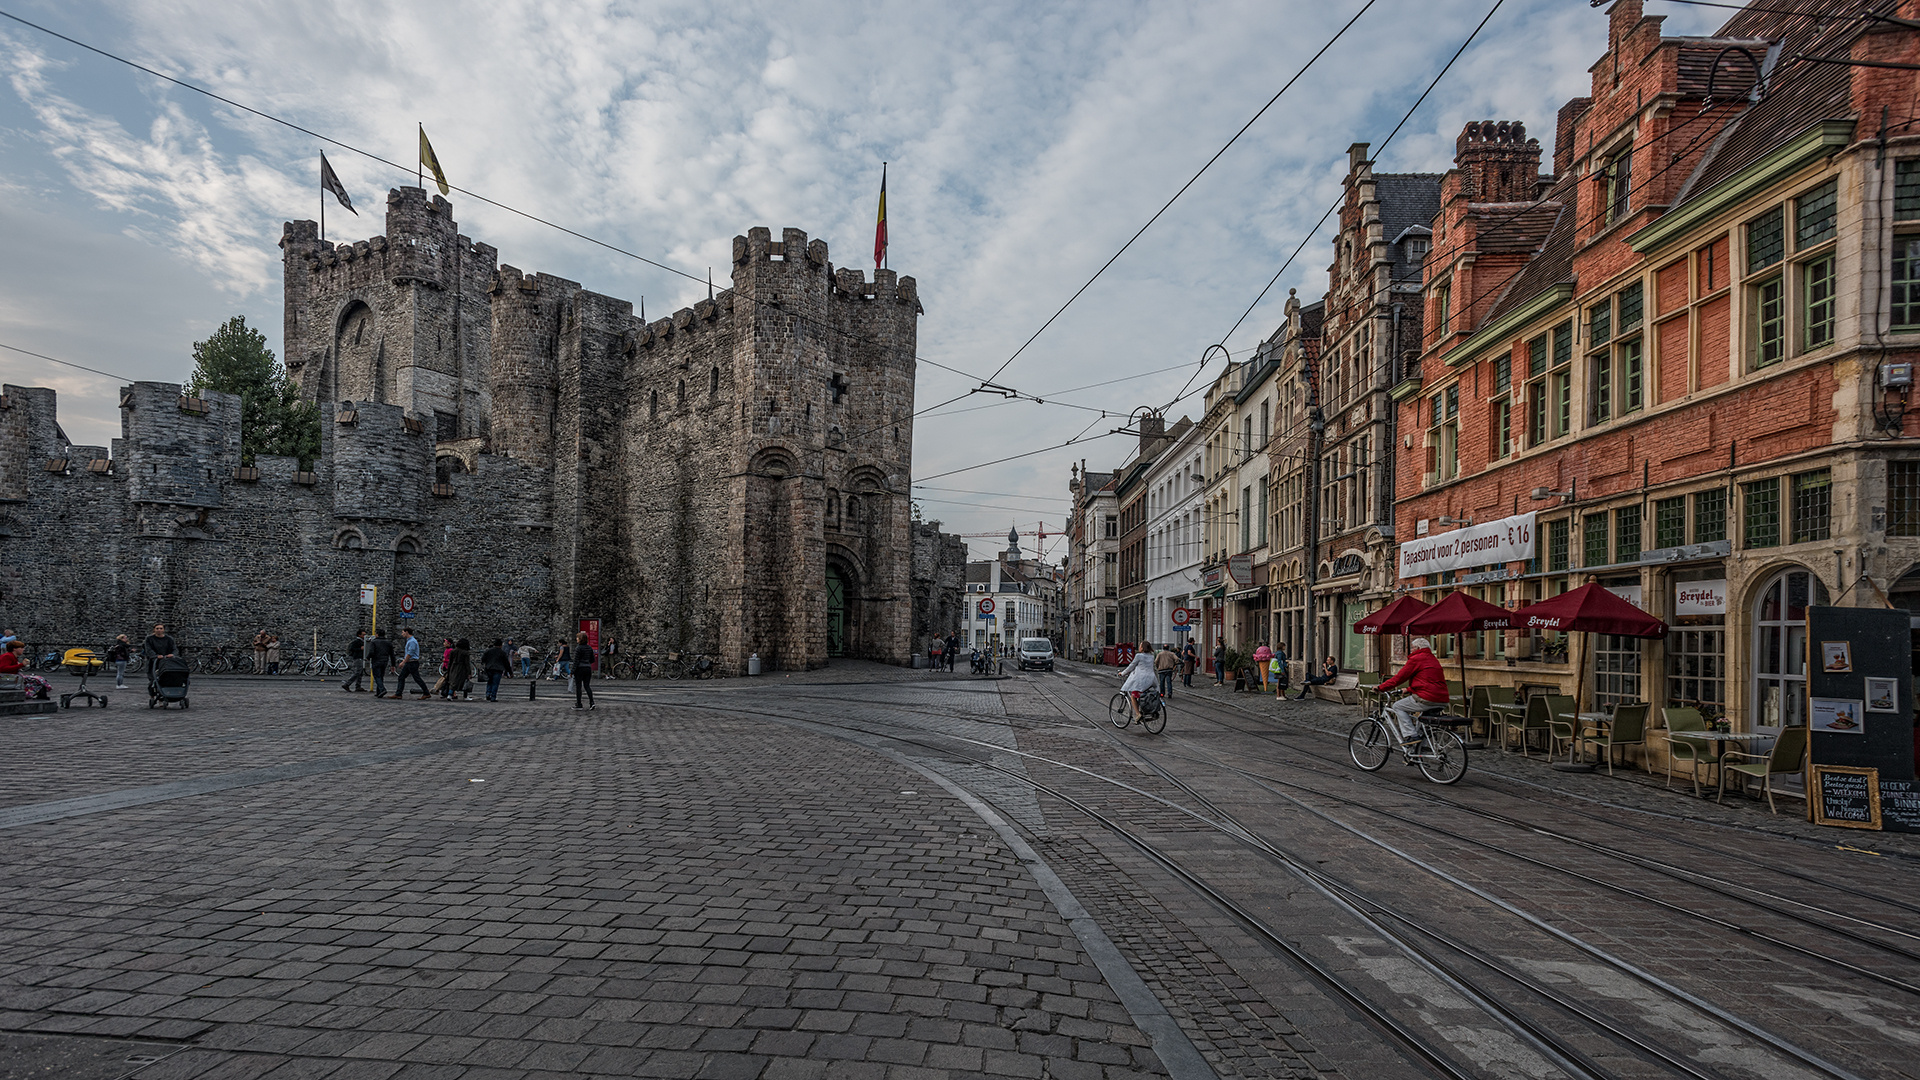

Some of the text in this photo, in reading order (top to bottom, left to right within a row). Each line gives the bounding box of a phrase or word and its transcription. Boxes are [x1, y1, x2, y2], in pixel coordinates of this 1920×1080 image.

[1403, 544, 1436, 568] Tapasbord
[1437, 543, 1454, 559] voor
[1454, 538, 1460, 556] 2
[1461, 534, 1499, 558] personen
[1508, 527, 1514, 546] €
[1516, 524, 1530, 544] 16
[1679, 590, 1713, 604] Breydel
[1527, 615, 1561, 629] Breydel
[1880, 782, 1911, 791] REGEN?
